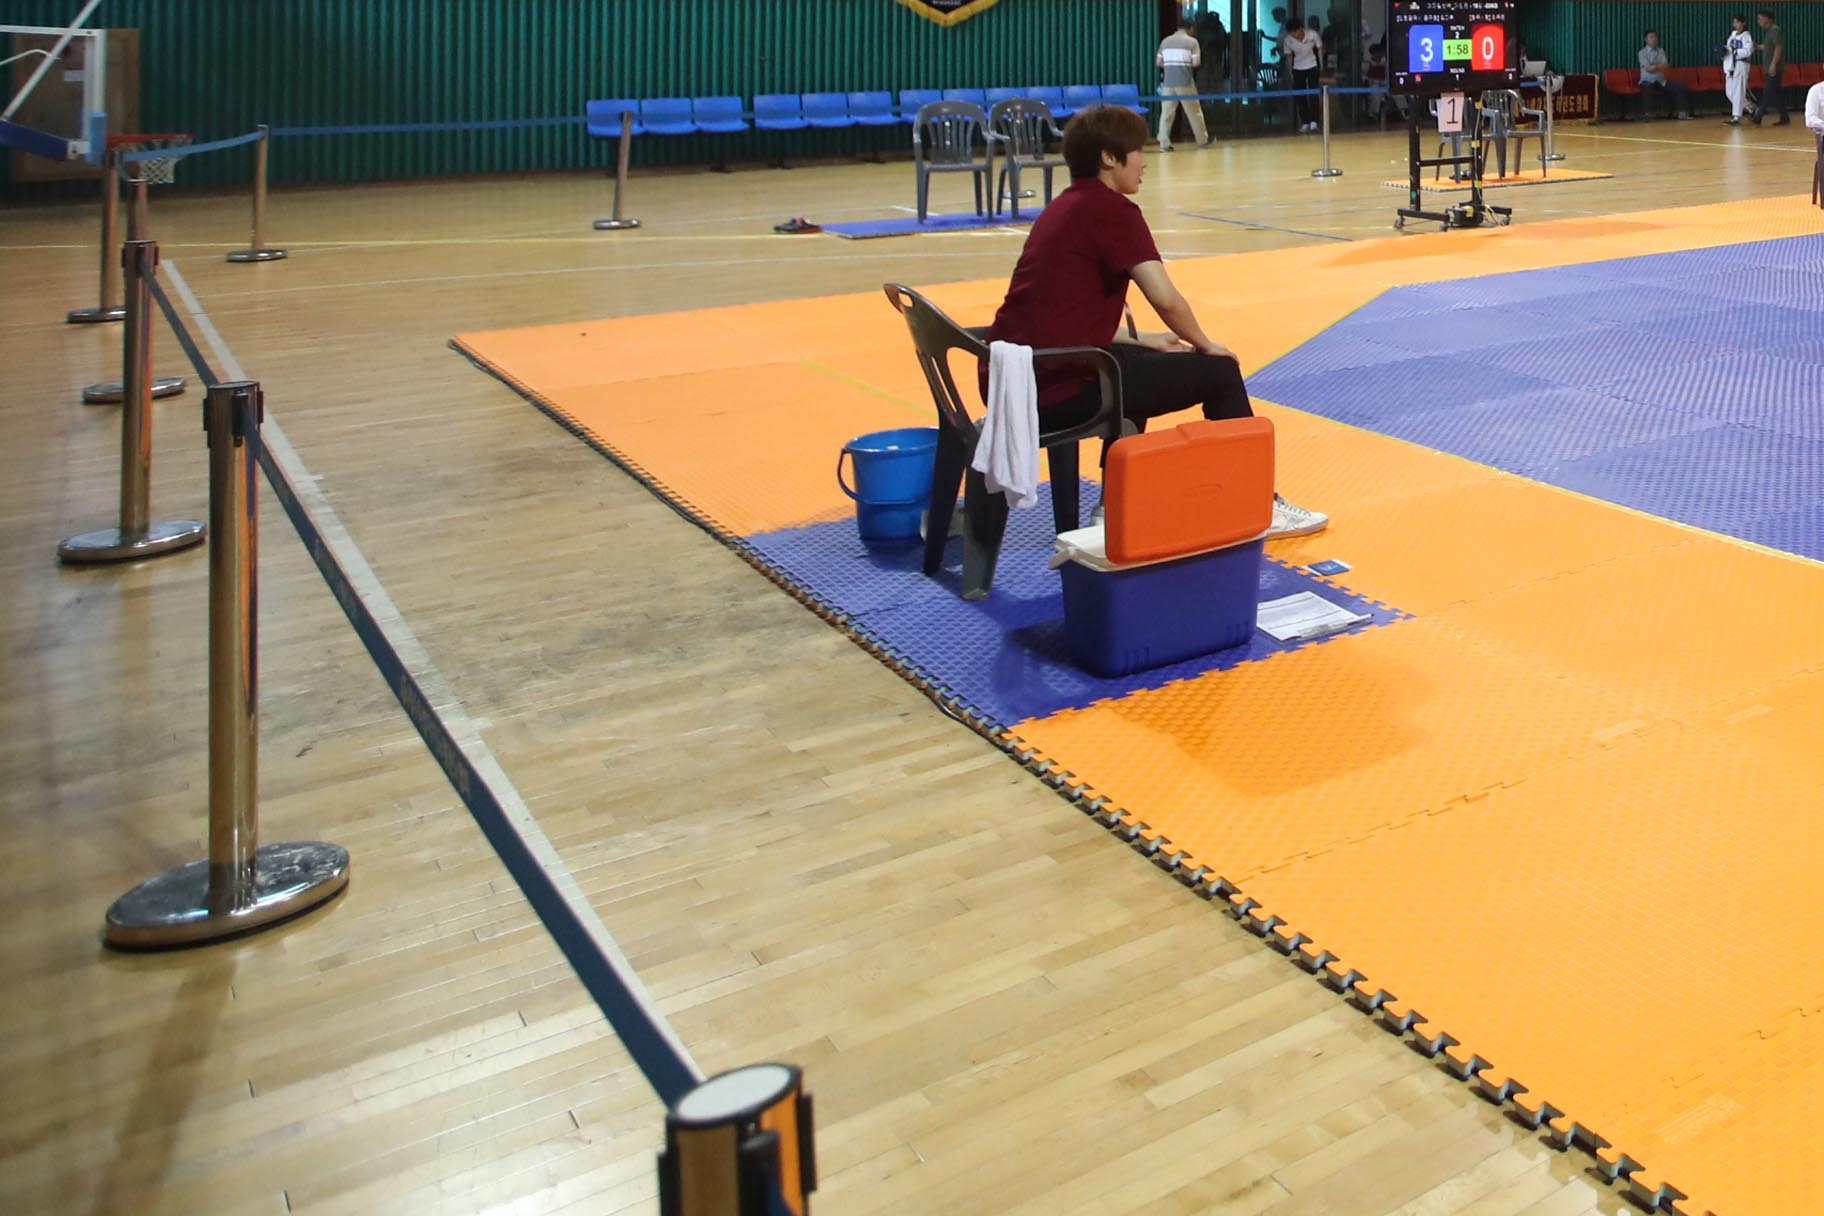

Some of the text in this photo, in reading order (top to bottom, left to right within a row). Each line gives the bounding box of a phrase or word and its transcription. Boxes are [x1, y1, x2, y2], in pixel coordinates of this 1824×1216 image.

[1420, 37, 1434, 63] 3
[1446, 44, 1469, 55] 1:58
[1481, 36, 1494, 61] 0
[1446, 97, 1459, 125] 1
